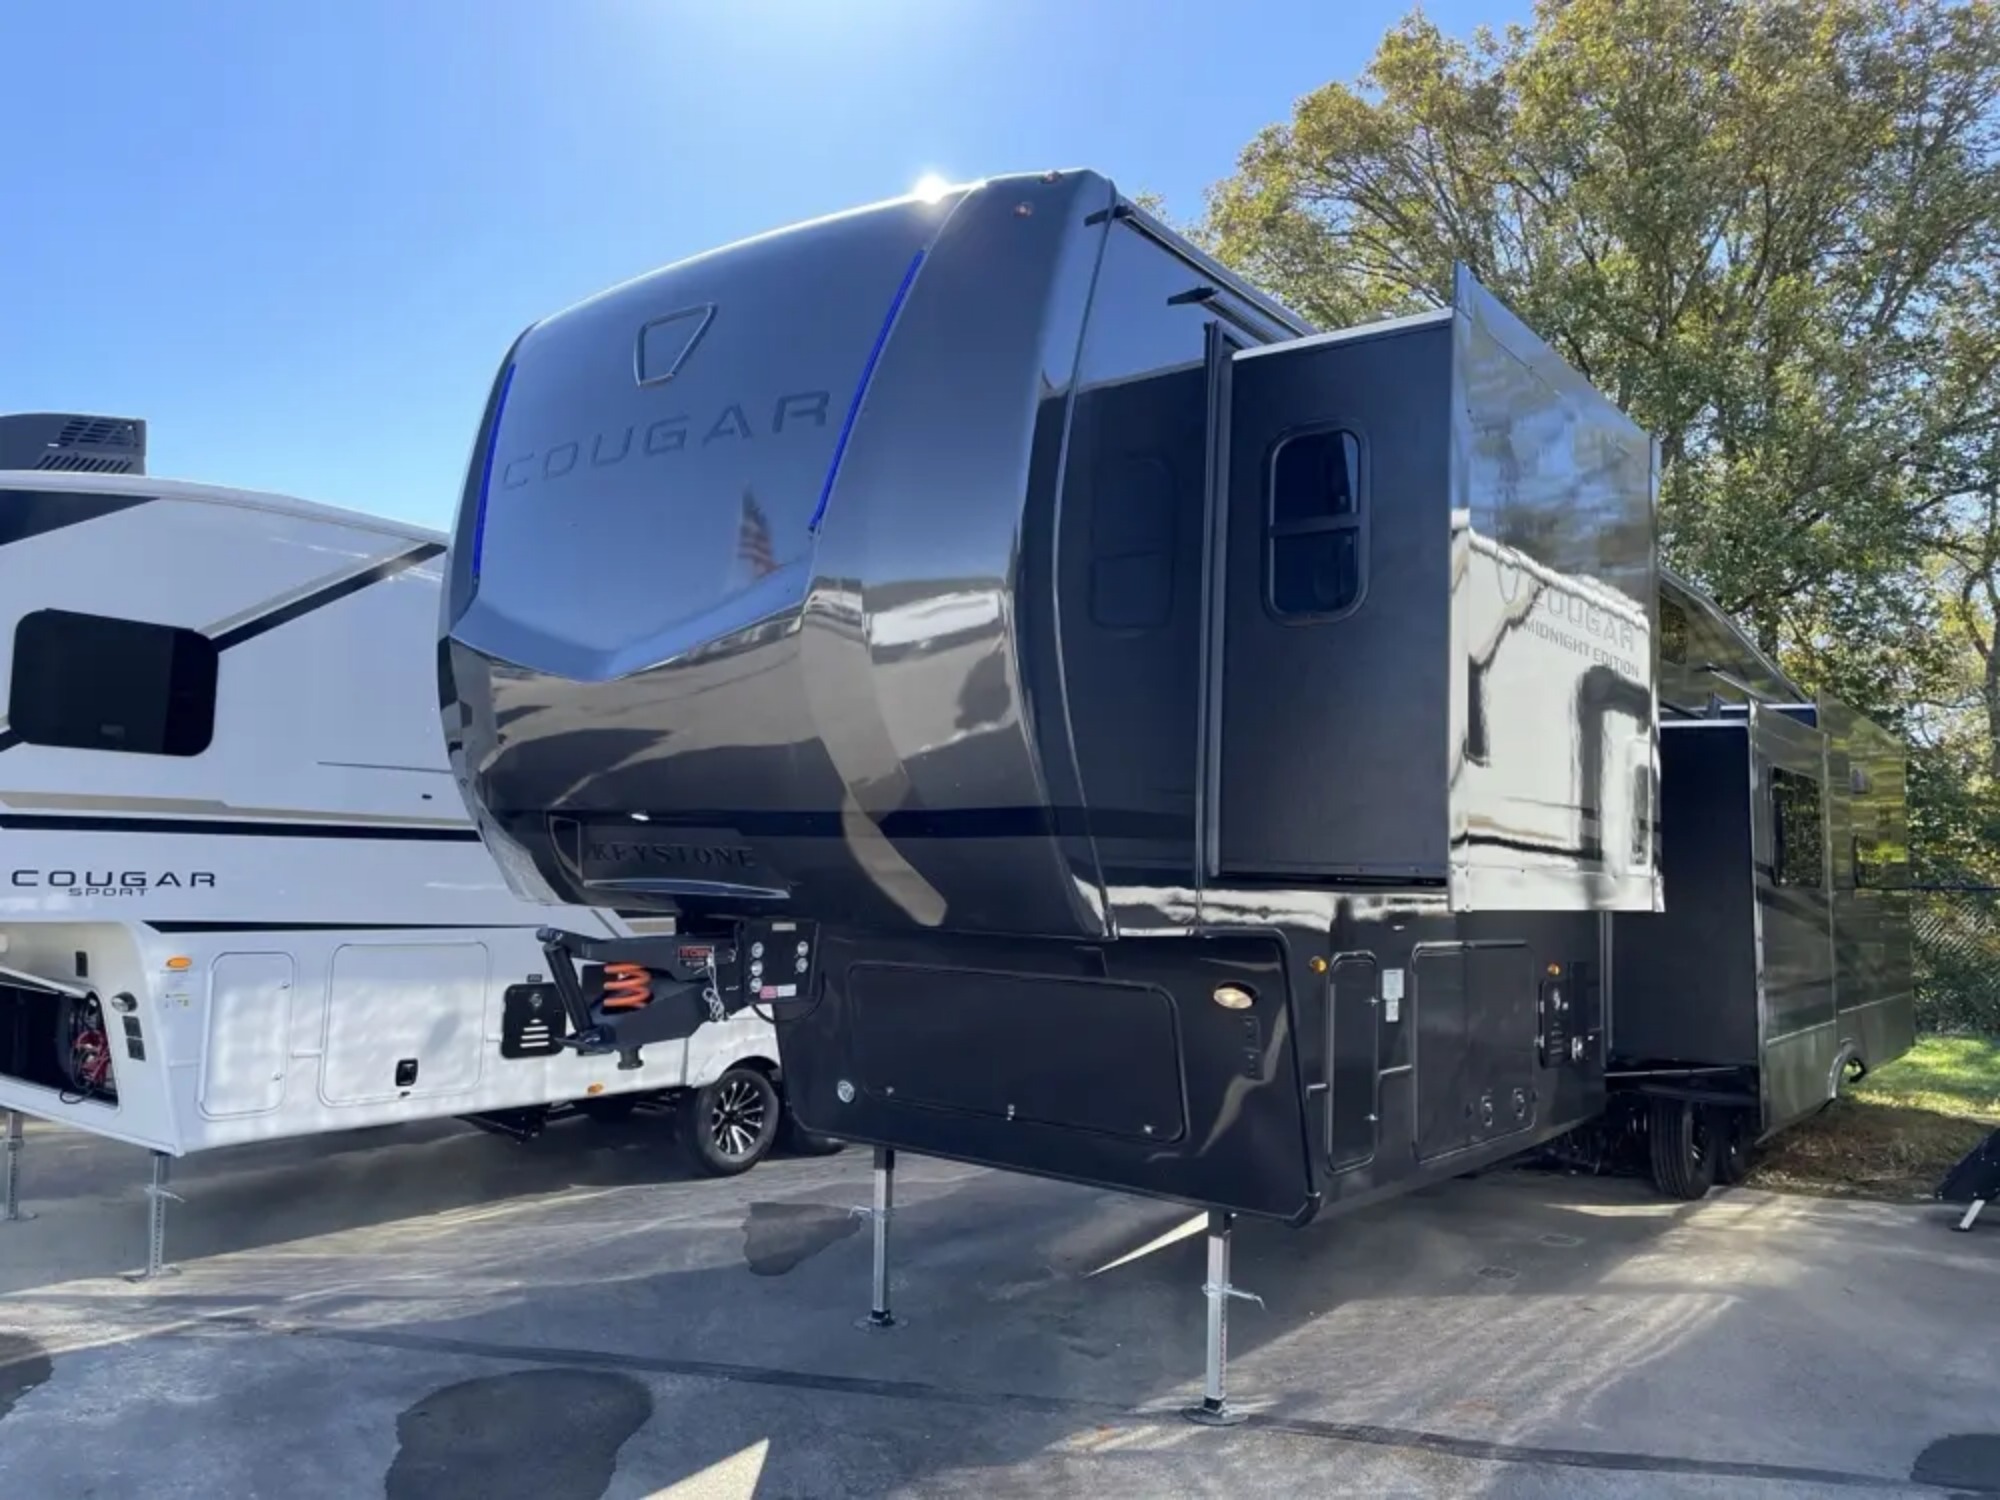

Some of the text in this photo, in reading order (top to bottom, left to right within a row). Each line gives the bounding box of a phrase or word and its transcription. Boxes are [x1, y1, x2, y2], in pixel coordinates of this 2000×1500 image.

[502, 390, 832, 490] COUGAR
[1523, 618, 1640, 679] MIDNIGHT EDITION
[592, 842, 757, 868] KEYSTONE
[11, 869, 216, 888] COUGAR
[68, 887, 150, 897] SPORT
